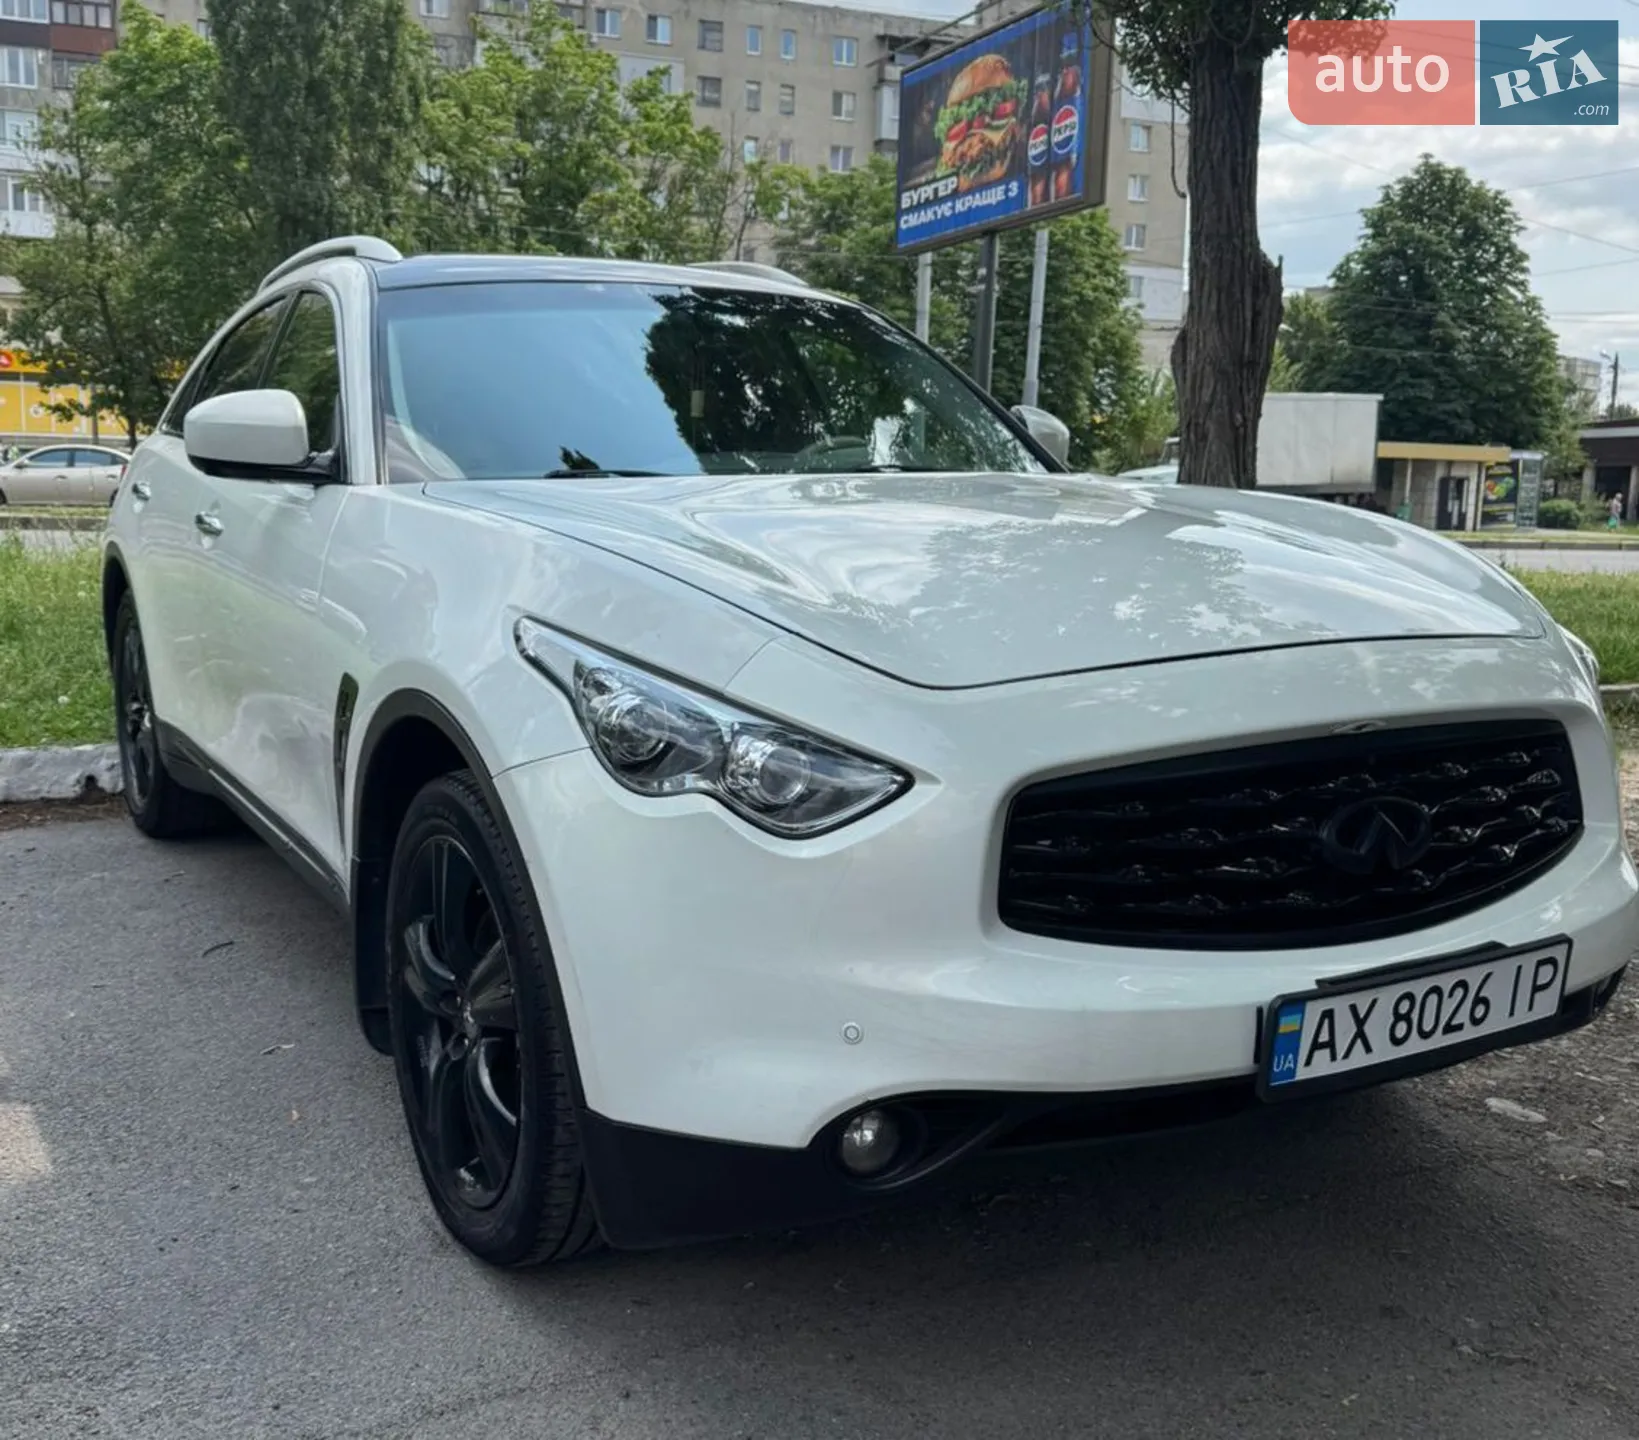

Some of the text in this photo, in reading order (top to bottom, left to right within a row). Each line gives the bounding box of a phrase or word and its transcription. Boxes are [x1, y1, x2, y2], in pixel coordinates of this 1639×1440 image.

[901, 175, 958, 209] БУРГЕР
[955, 184, 1006, 214] КРАЩЕ
[1304, 956, 1559, 1067] AX 8026 IP
[1272, 1052, 1295, 1073] UA
